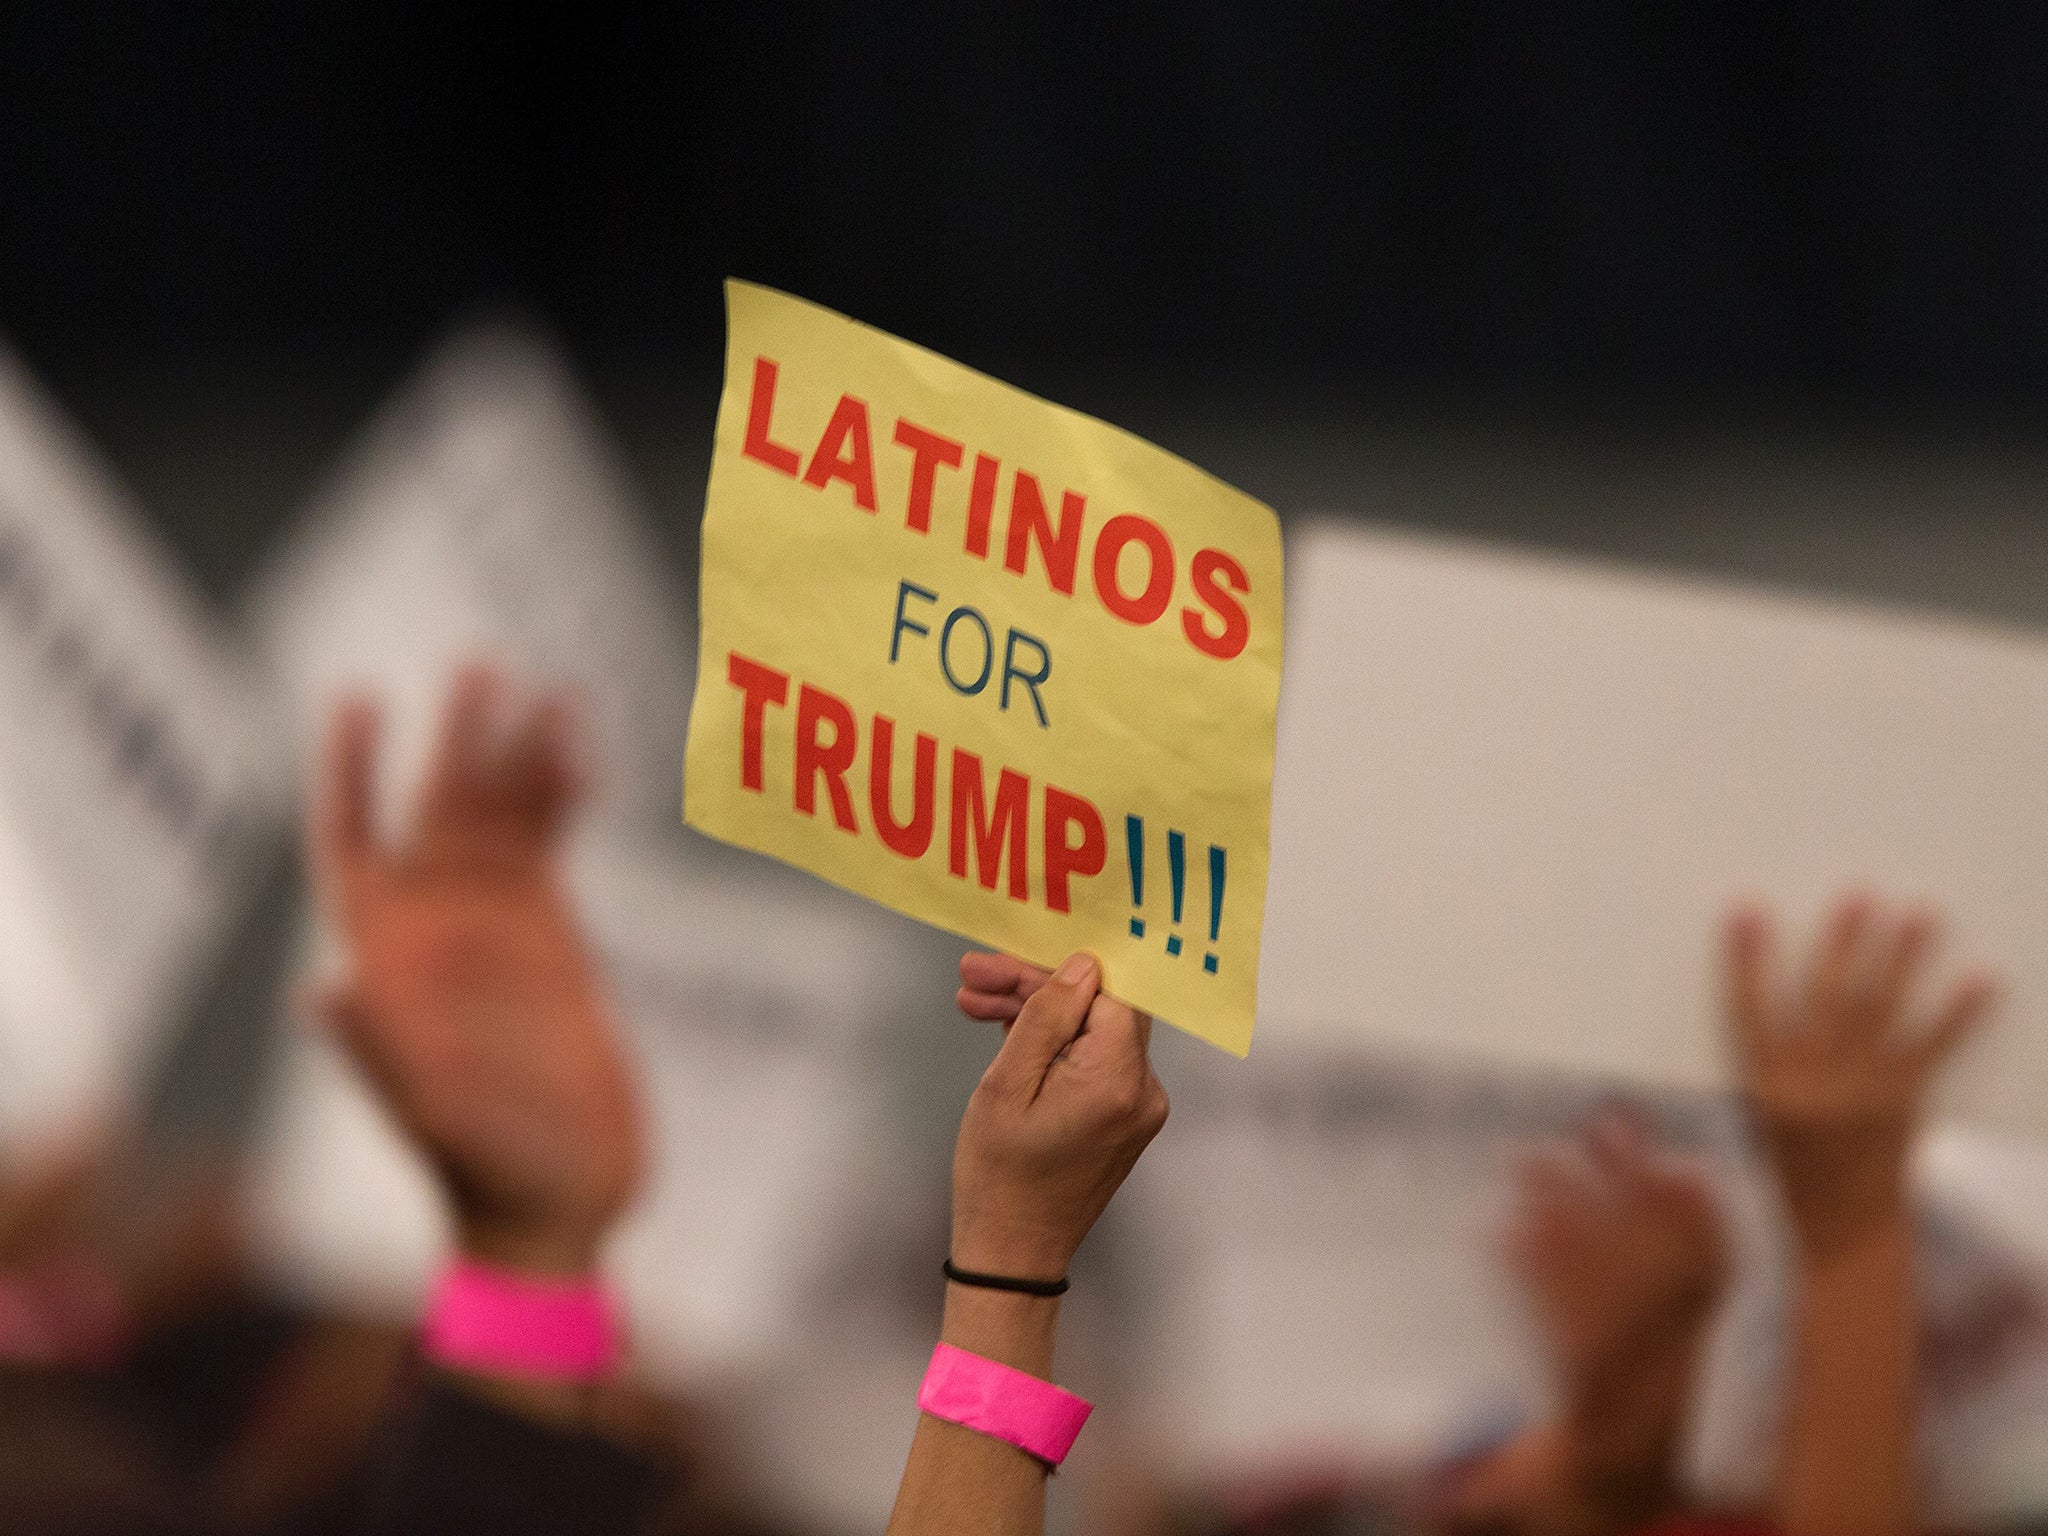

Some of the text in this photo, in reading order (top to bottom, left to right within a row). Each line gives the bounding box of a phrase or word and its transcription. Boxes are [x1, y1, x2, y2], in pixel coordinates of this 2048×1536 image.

[742, 356, 1251, 661] LATINOS
[888, 582, 1052, 728] FOR
[726, 653, 1228, 975] TRUMP!!!
